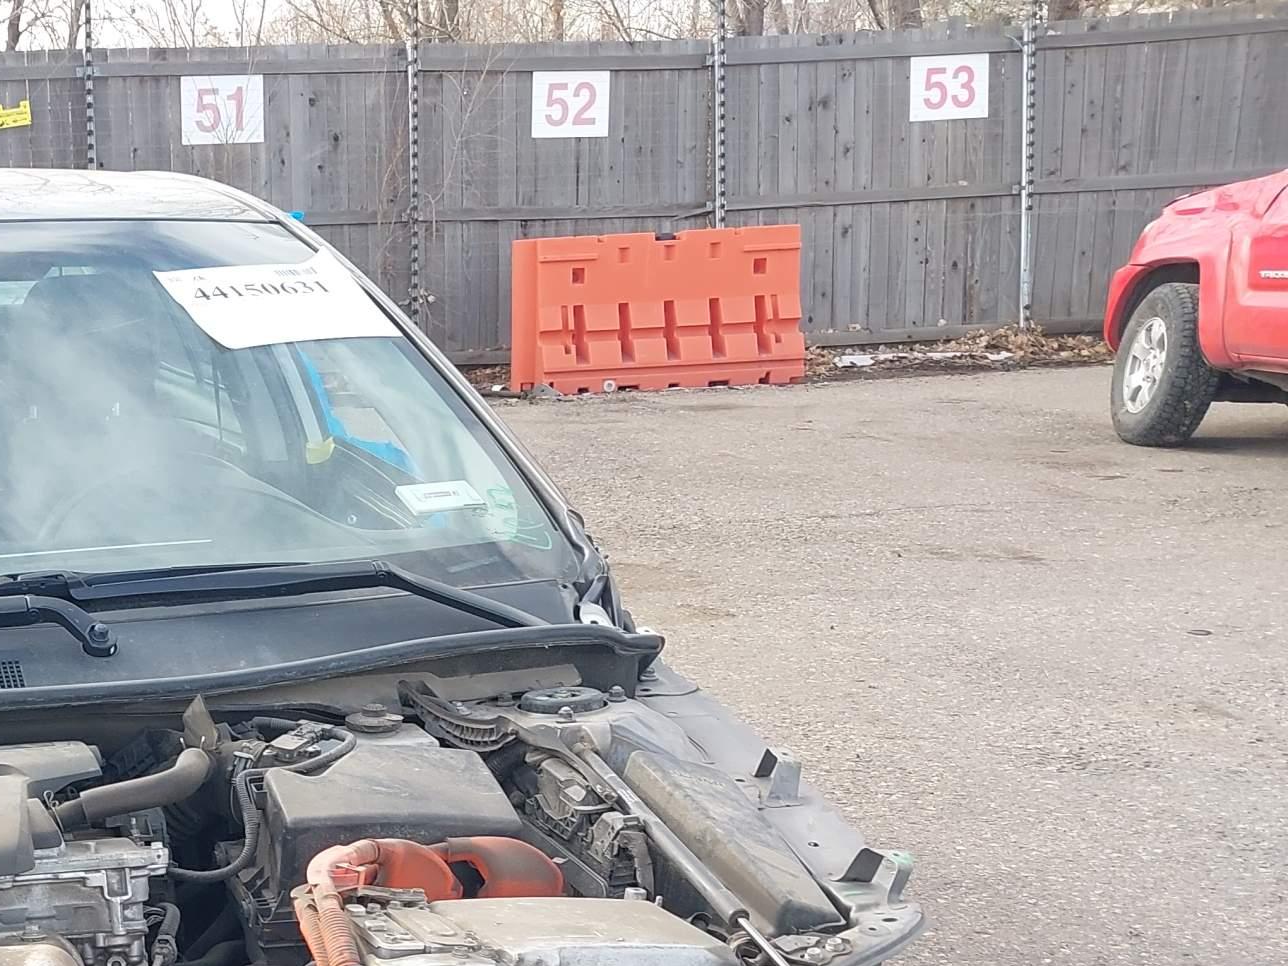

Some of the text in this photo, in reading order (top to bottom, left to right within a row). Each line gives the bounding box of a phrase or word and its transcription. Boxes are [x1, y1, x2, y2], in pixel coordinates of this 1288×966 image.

[544, 81, 597, 127] 52
[922, 64, 977, 110] 53
[195, 87, 246, 134] 51
[194, 280, 329, 301] 44150631
